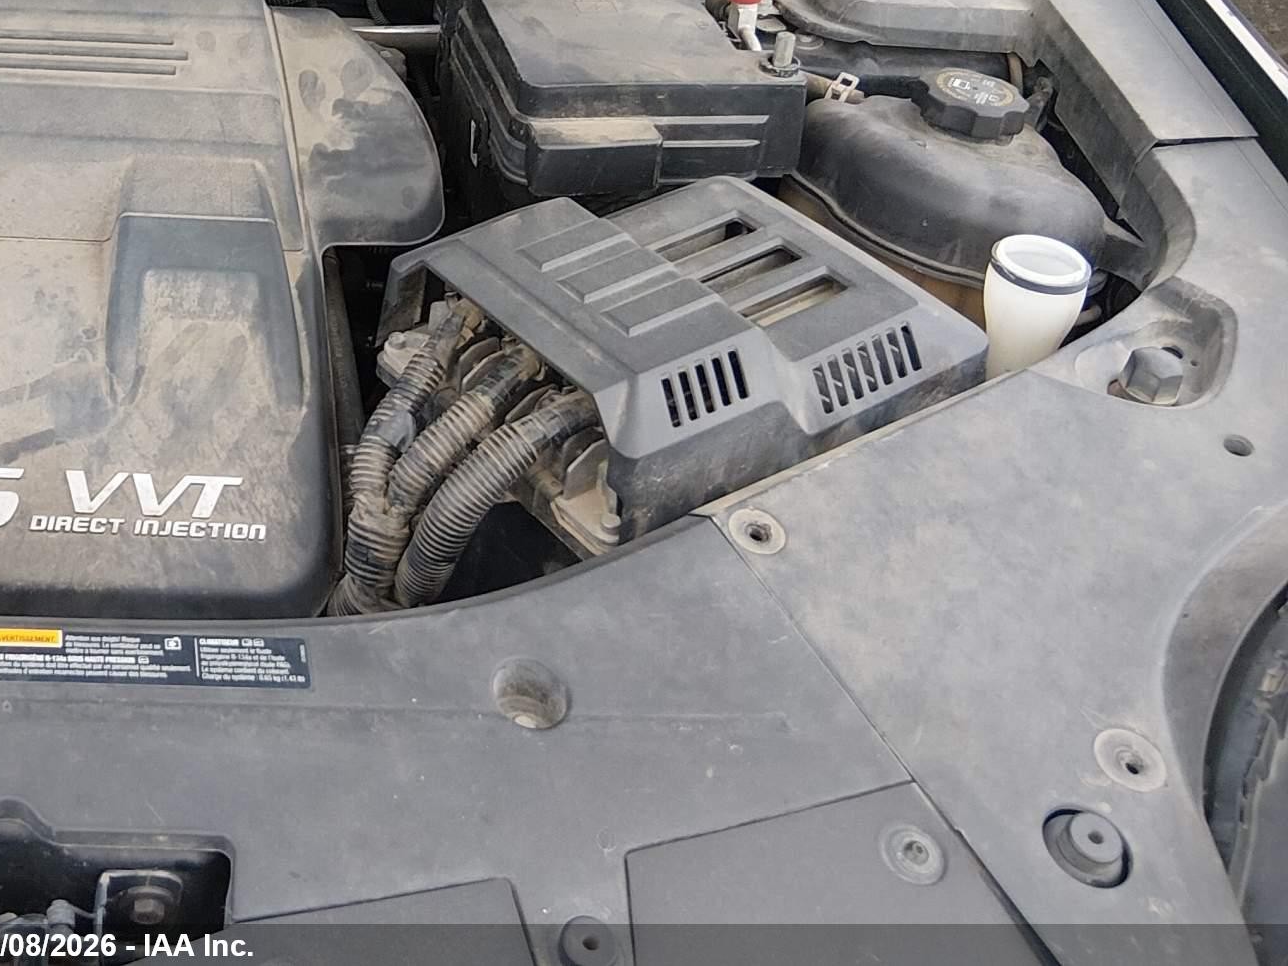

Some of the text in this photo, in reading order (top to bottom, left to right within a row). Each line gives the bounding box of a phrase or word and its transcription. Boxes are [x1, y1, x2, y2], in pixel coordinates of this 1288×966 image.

[65, 469, 244, 519] VVT
[29, 515, 267, 541] DIRECT INJECTION
